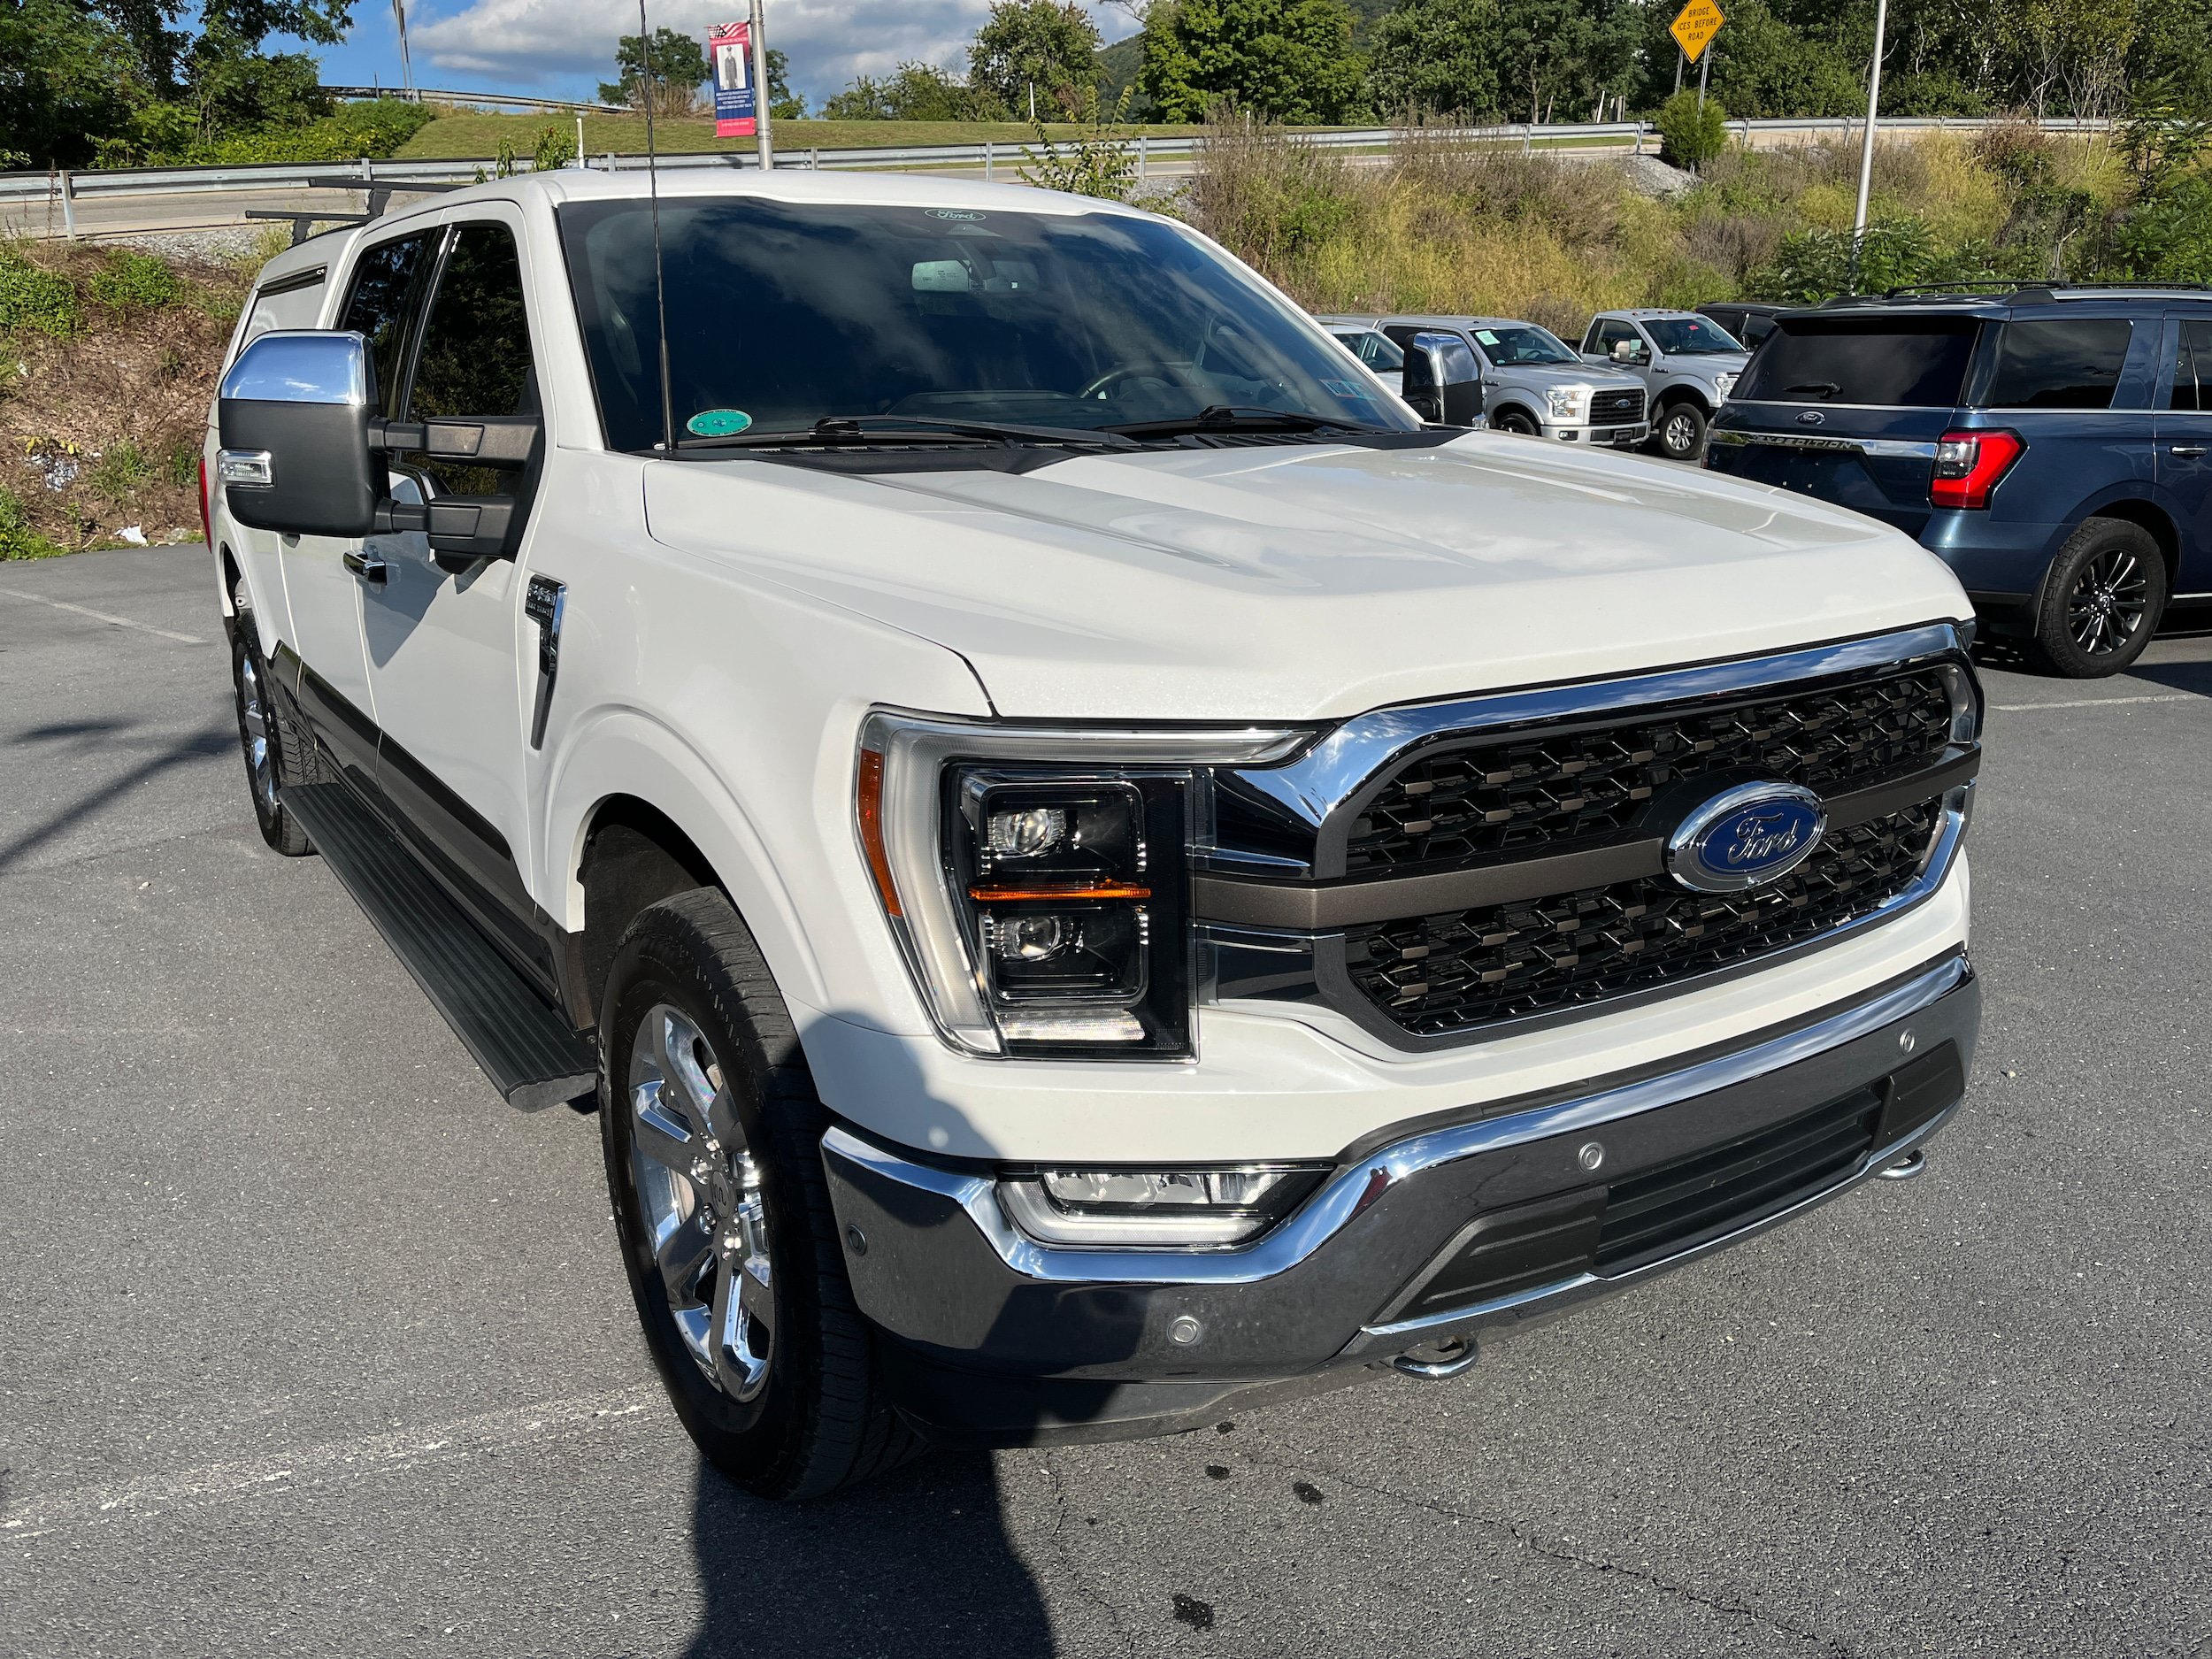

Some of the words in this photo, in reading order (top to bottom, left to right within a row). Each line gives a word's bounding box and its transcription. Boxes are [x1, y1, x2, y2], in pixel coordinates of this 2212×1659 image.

[1688, 7, 1709, 18] BRIDGE
[1695, 18, 1717, 28] BEFORE
[1688, 32, 1703, 41] ROAD
[936, 209, 977, 219] Ford
[1754, 434, 1853, 449] EXPEDITION
[1727, 812, 1801, 865] Ford
